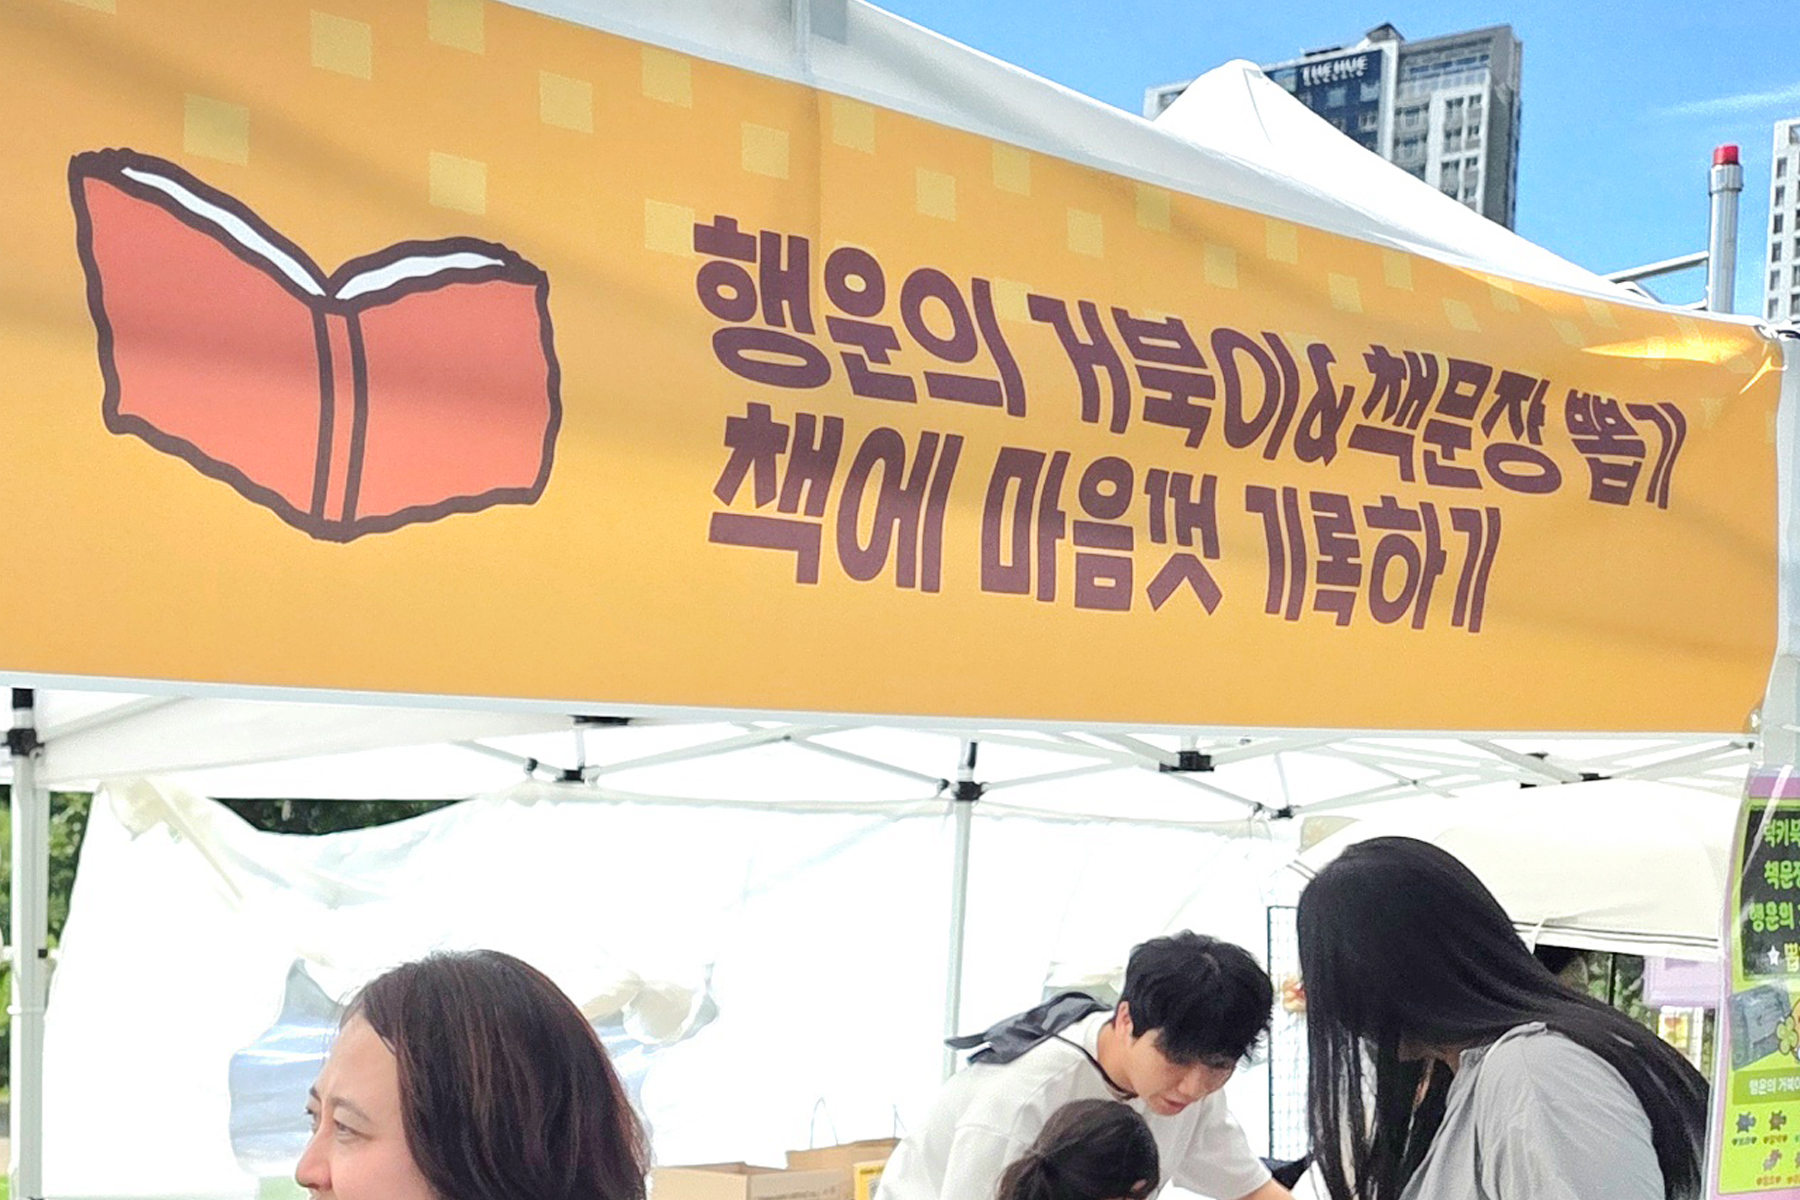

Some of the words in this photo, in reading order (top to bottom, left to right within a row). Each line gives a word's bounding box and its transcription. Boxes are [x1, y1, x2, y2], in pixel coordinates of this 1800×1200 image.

[693, 214, 1028, 417] 행운의
[1026, 294, 1563, 495] 거북이&책문장
[1564, 388, 1688, 511] 뽑기
[707, 402, 963, 593] 책에
[980, 446, 1223, 617] 마음껏
[1244, 485, 1501, 633] 기록하기
[1749, 901, 1795, 932] 행운의
[1749, 1078, 1776, 1096] 행운의
